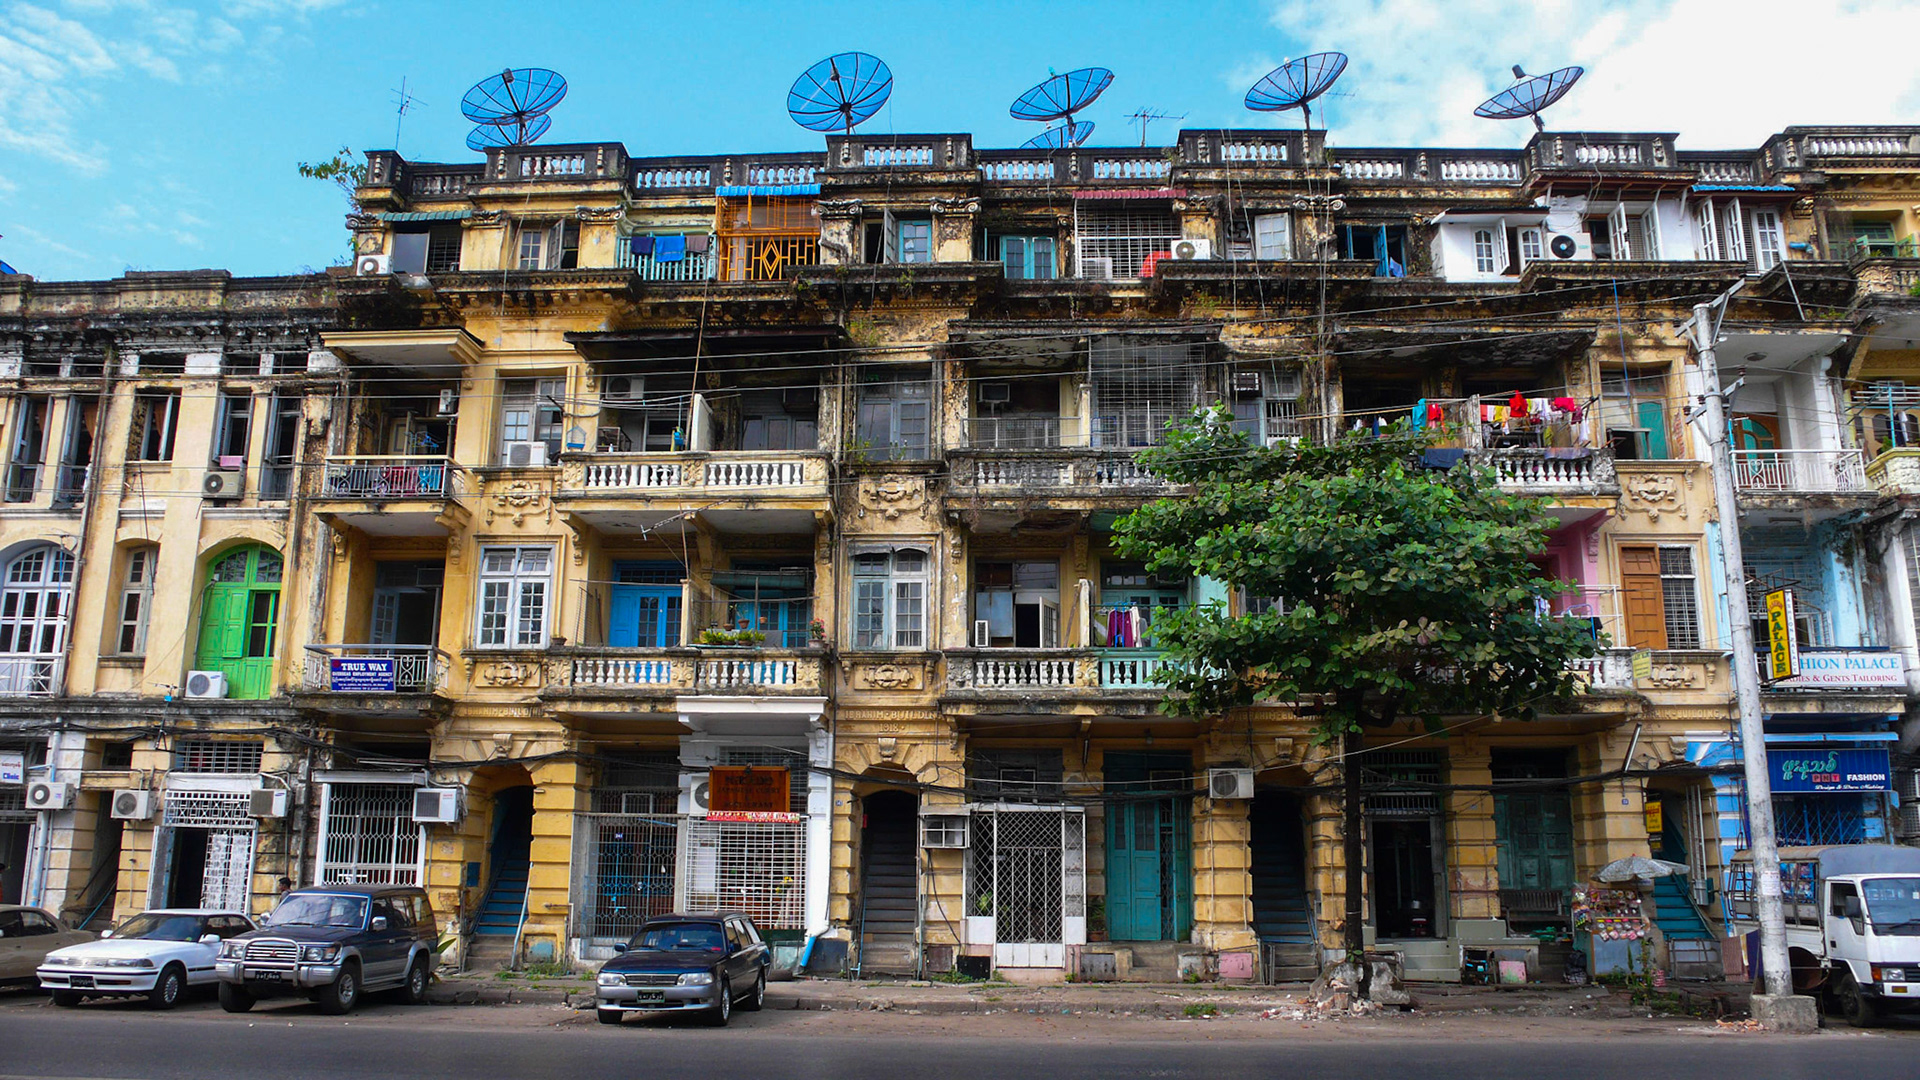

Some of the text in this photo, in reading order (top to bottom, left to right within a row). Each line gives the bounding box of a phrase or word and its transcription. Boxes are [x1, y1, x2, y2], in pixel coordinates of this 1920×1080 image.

[1771, 612, 1787, 673] PALACE
[341, 663, 388, 671] TRUE WAY
[1845, 657, 1899, 669] PALACE
[1812, 674, 1821, 682] &
[1851, 674, 1898, 682] TAILORING
[845, 710, 884, 719] IBRAHIM
[879, 723, 899, 733] 1918
